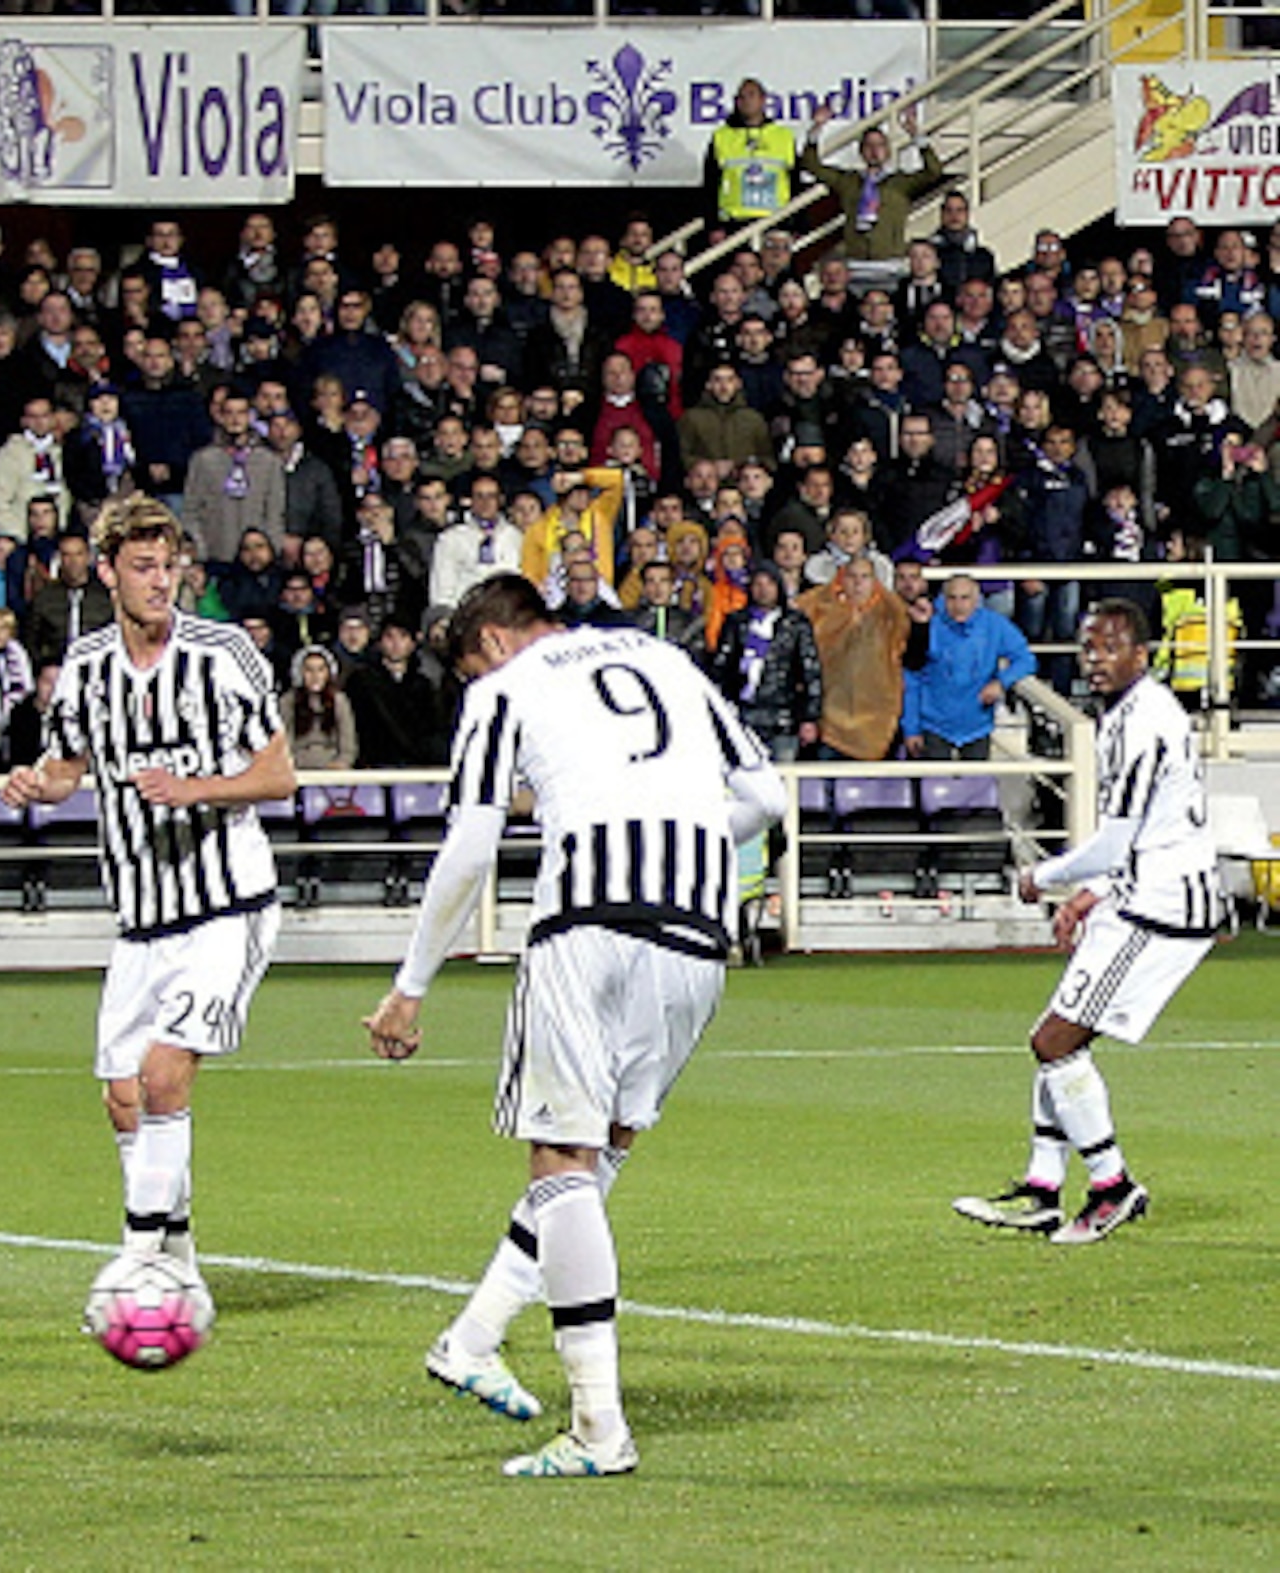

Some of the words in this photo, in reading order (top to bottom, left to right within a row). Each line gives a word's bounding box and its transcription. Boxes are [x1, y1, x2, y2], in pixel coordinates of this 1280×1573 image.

[128, 52, 288, 177] Viola
[333, 81, 457, 125] Viola
[473, 80, 579, 126] Club
[590, 663, 672, 764] 9
[1060, 968, 1091, 1009] 3
[164, 990, 225, 1042] 24
